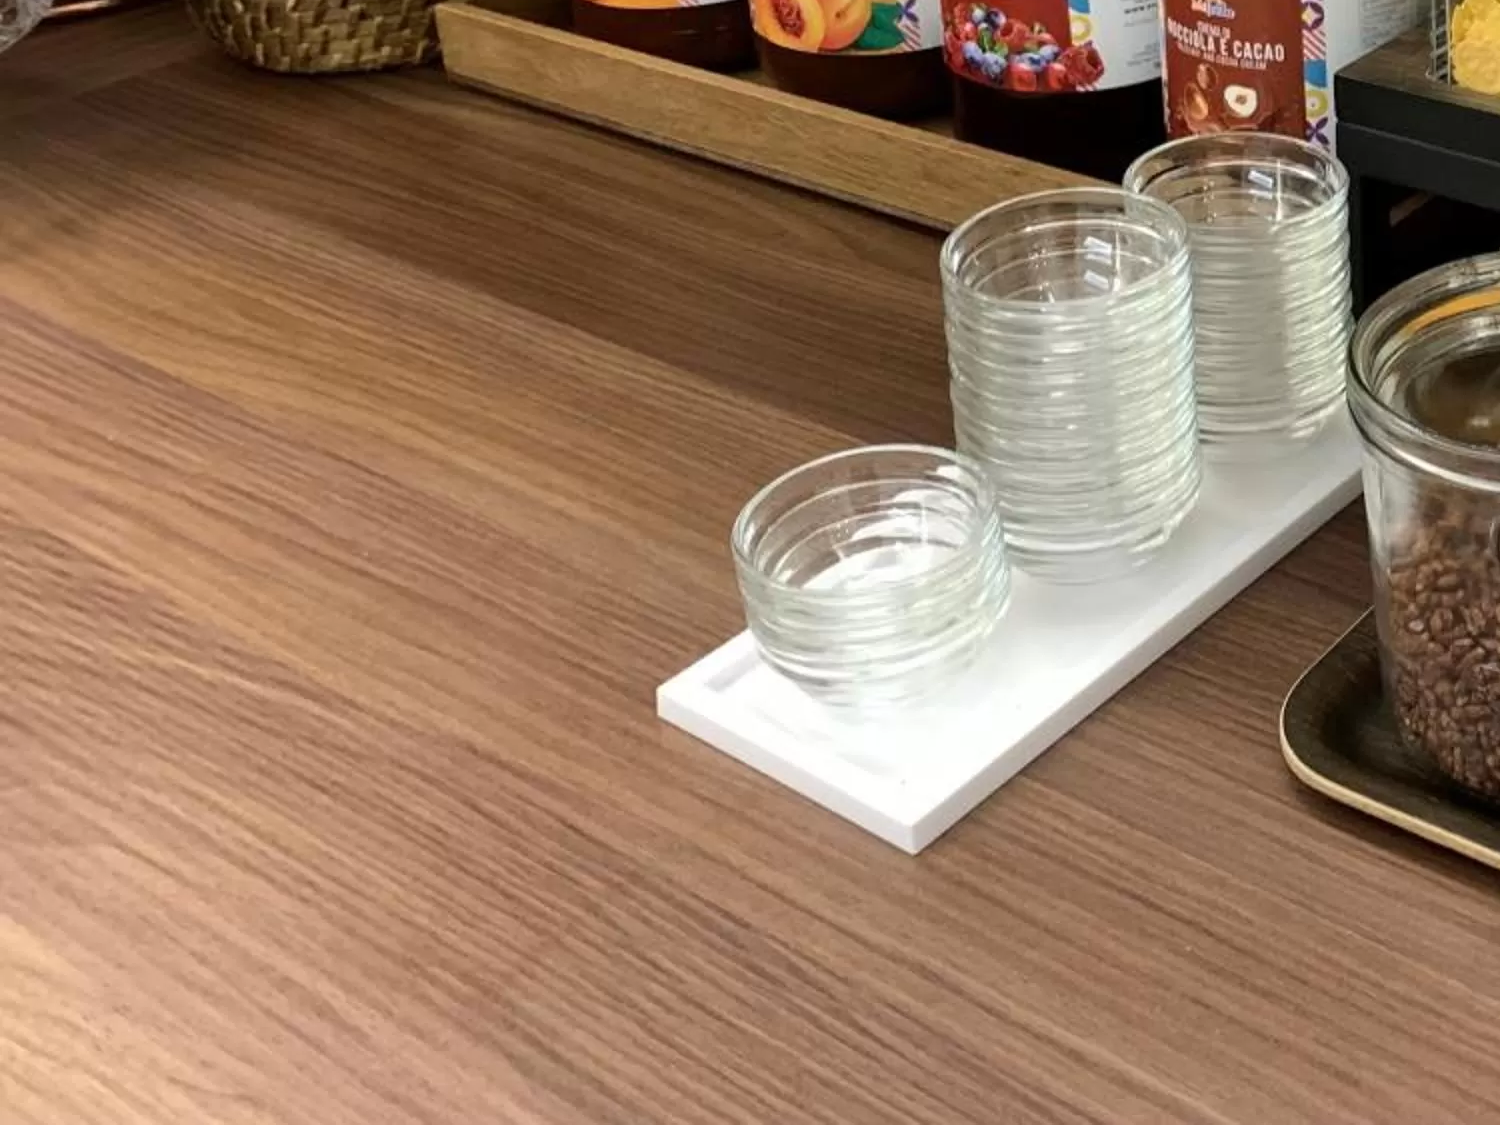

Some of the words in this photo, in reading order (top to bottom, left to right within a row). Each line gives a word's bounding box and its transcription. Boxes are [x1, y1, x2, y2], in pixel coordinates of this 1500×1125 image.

[1167, 16, 1216, 53] NOCCIOLA
[1220, 37, 1229, 56] E
[1233, 40, 1285, 63] CACAO
